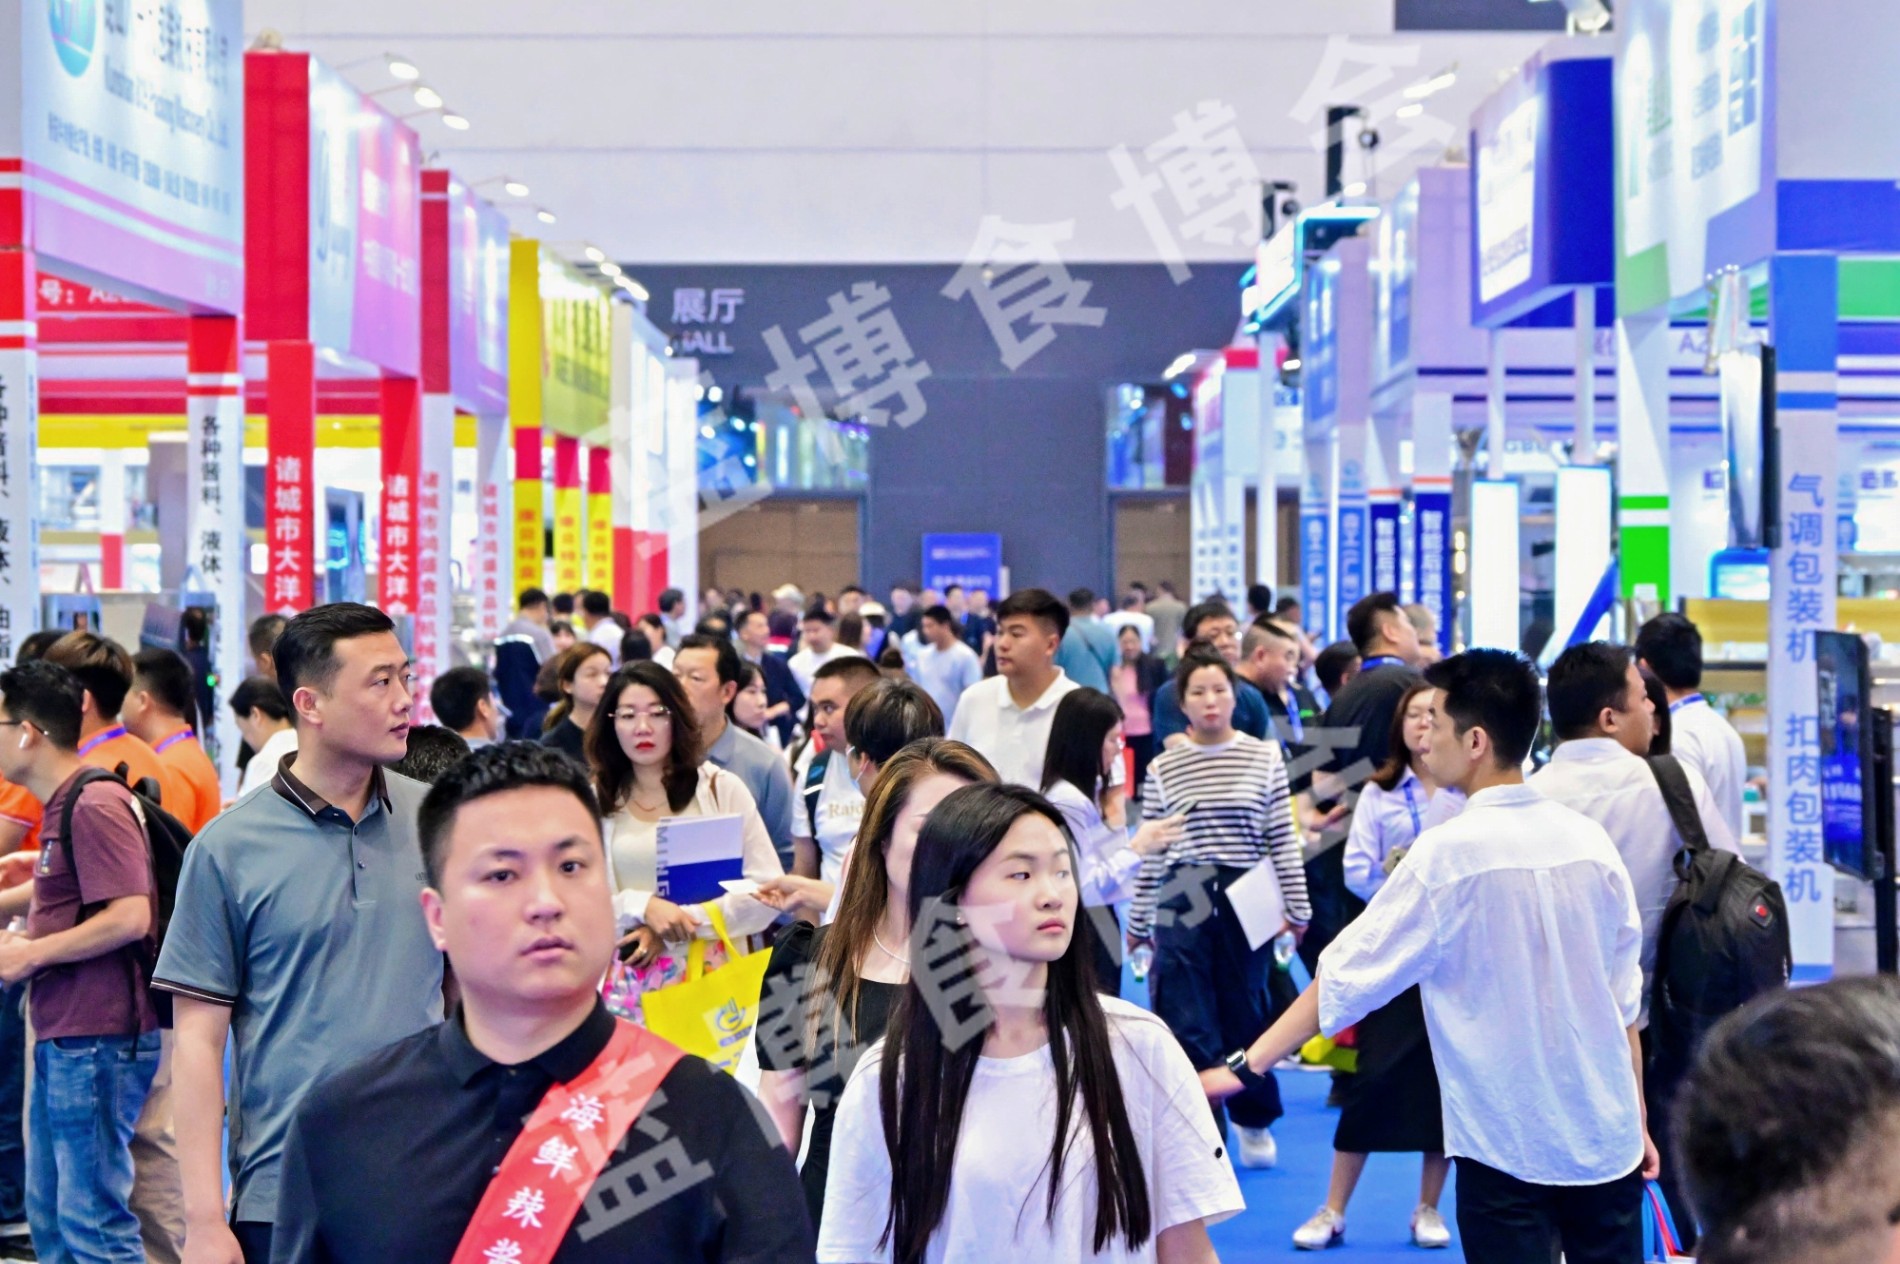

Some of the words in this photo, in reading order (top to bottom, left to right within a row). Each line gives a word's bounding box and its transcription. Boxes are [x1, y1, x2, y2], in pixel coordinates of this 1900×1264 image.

[671, 288, 745, 324] 展厅
[1786, 474, 1825, 662] 气调包装机
[1784, 714, 1822, 903] 扣肉包装机
